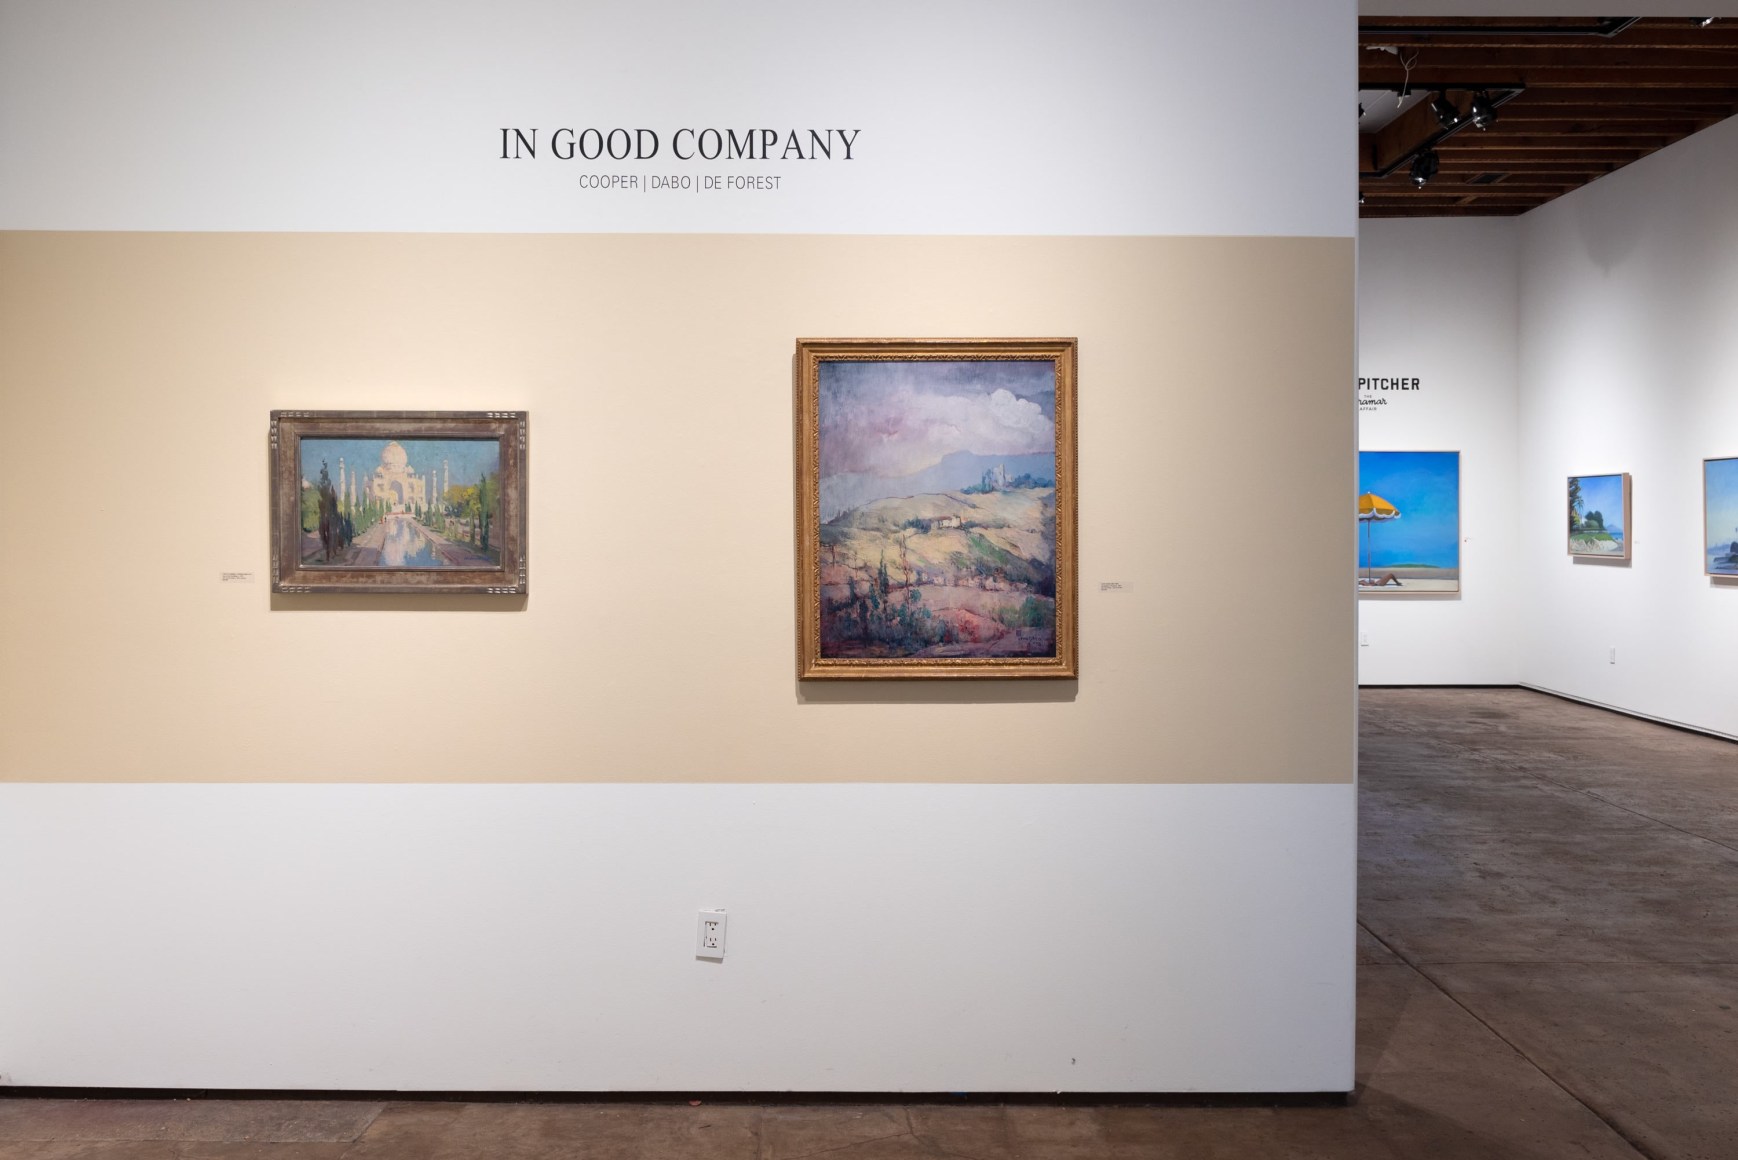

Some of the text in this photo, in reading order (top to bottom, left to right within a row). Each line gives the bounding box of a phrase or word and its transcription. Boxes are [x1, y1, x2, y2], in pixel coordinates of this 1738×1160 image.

[500, 128, 862, 161] IN GOOD COMPANY
[579, 174, 639, 189] COOPER
[651, 175, 692, 190] DABO
[704, 175, 722, 190] DE
[727, 175, 781, 190] FOREST
[1358, 377, 1420, 391] PITCHER
